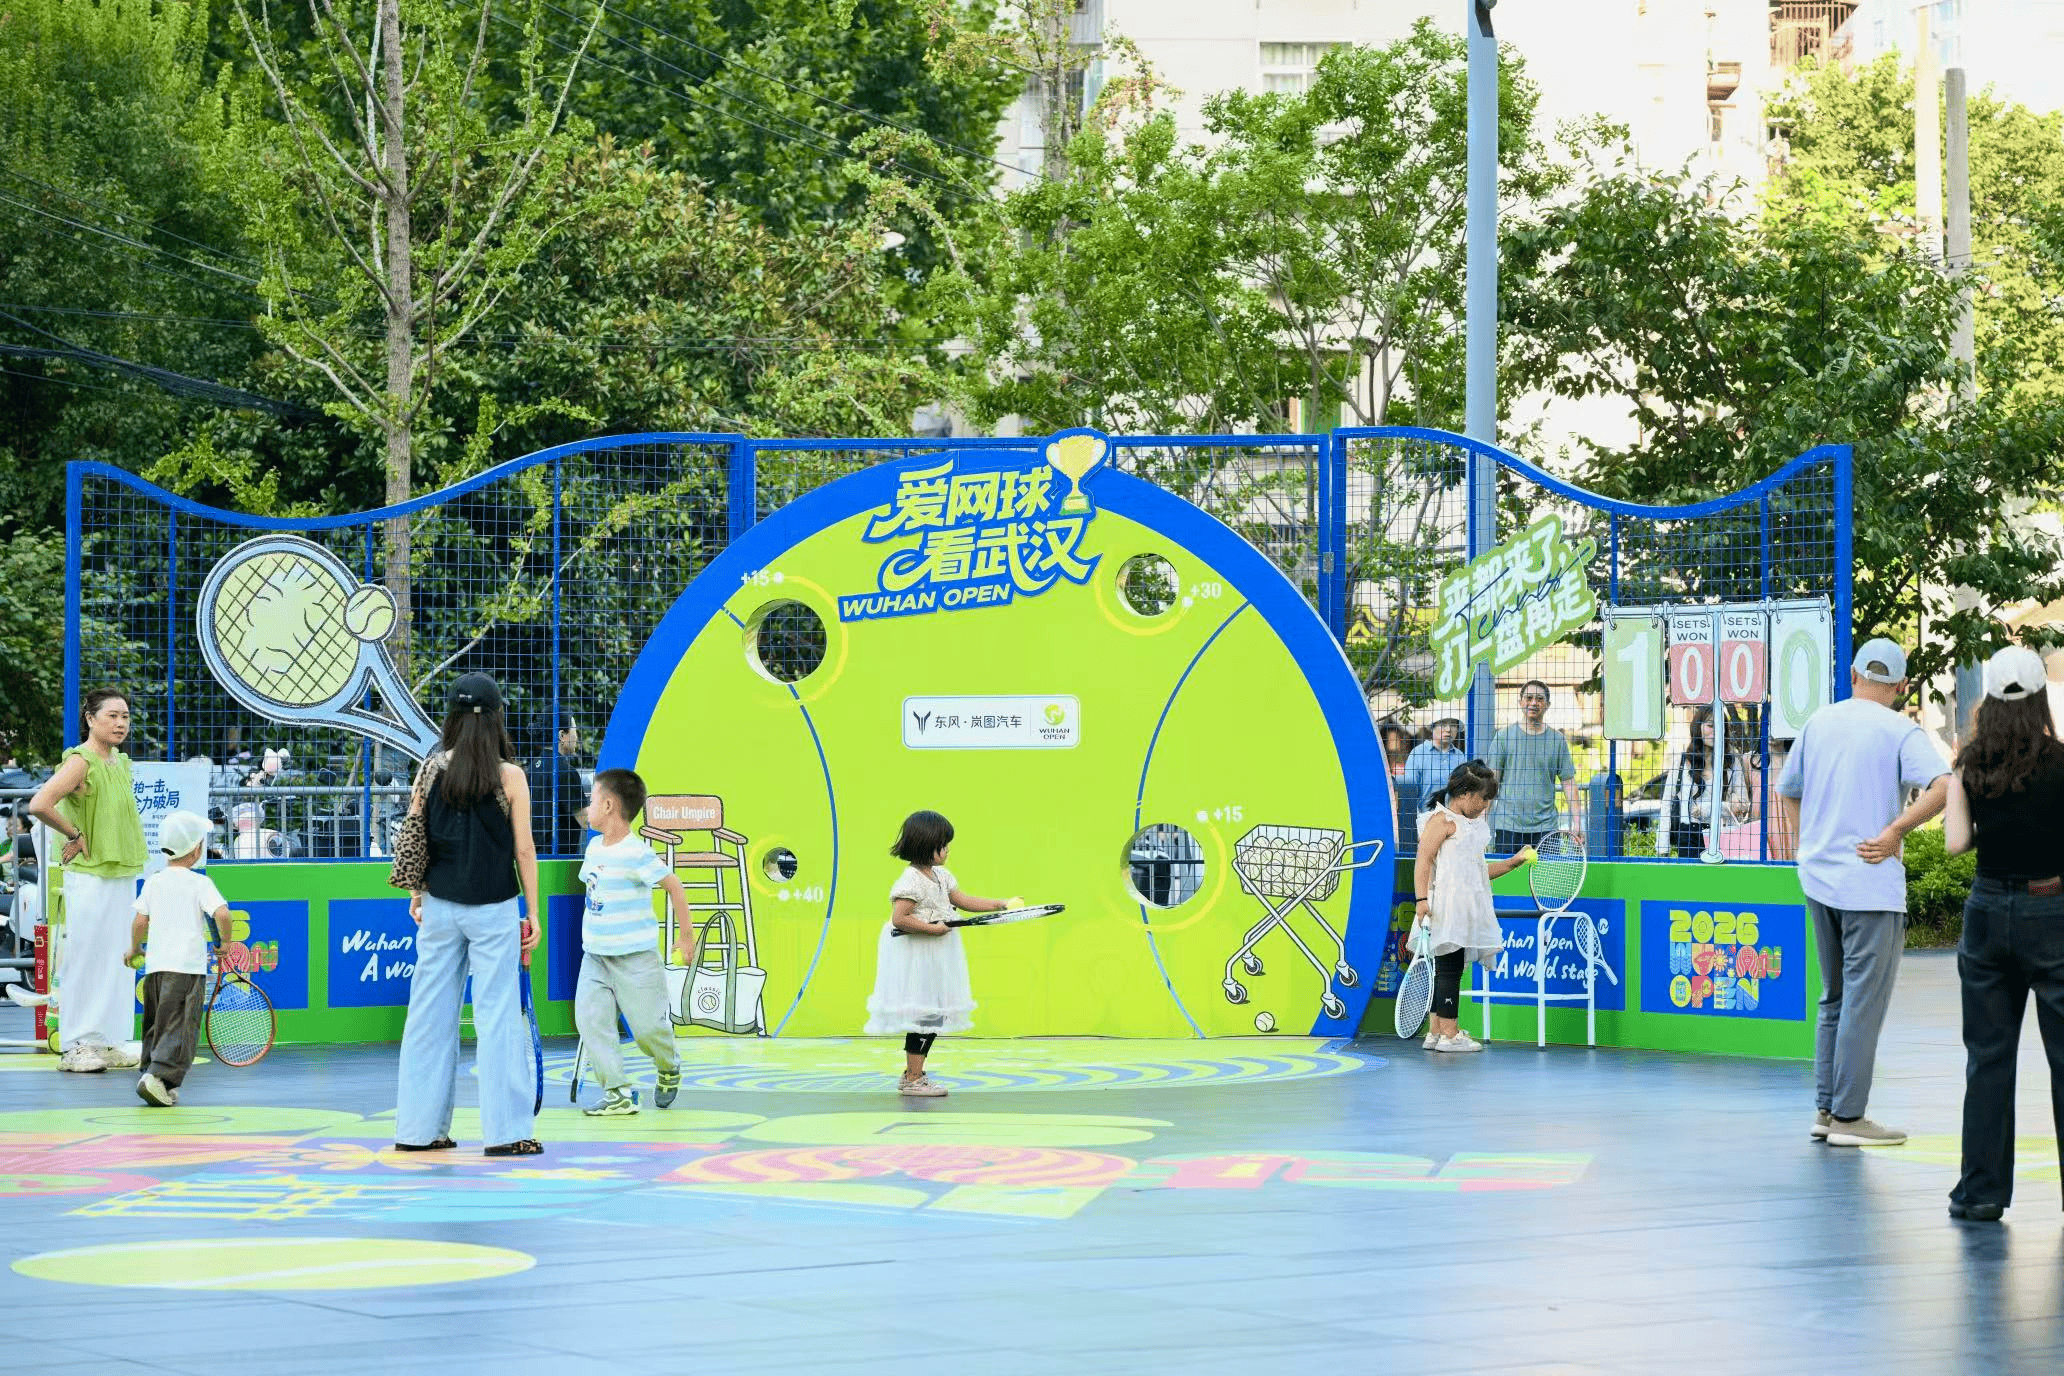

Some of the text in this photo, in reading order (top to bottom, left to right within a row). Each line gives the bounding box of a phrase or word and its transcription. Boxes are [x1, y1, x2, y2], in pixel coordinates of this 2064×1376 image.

[869, 459, 1052, 537] 爱网球
[883, 517, 1091, 592] 看武汉
[843, 583, 1011, 617] WUHAN OPEN
[1191, 582, 1222, 599] +30
[1677, 619, 1706, 629] SETS
[1728, 616, 1757, 626] SETS
[1677, 632, 1708, 641] WON
[1728, 629, 1759, 639] WON
[1617, 631, 1649, 731] 1
[132, 779, 168, 795] 拍一击，
[654, 806, 715, 822] Chair Umpire
[1213, 805, 1242, 823] +15
[794, 886, 823, 902] +40
[1670, 910, 1759, 945] 2026
[342, 930, 412, 953] Wuhan
[1500, 928, 1535, 950] uhan
[360, 953, 378, 982] A
[1495, 950, 1509, 980] A
[1514, 956, 1560, 979] wold
[1670, 974, 1759, 1011] OPEN
